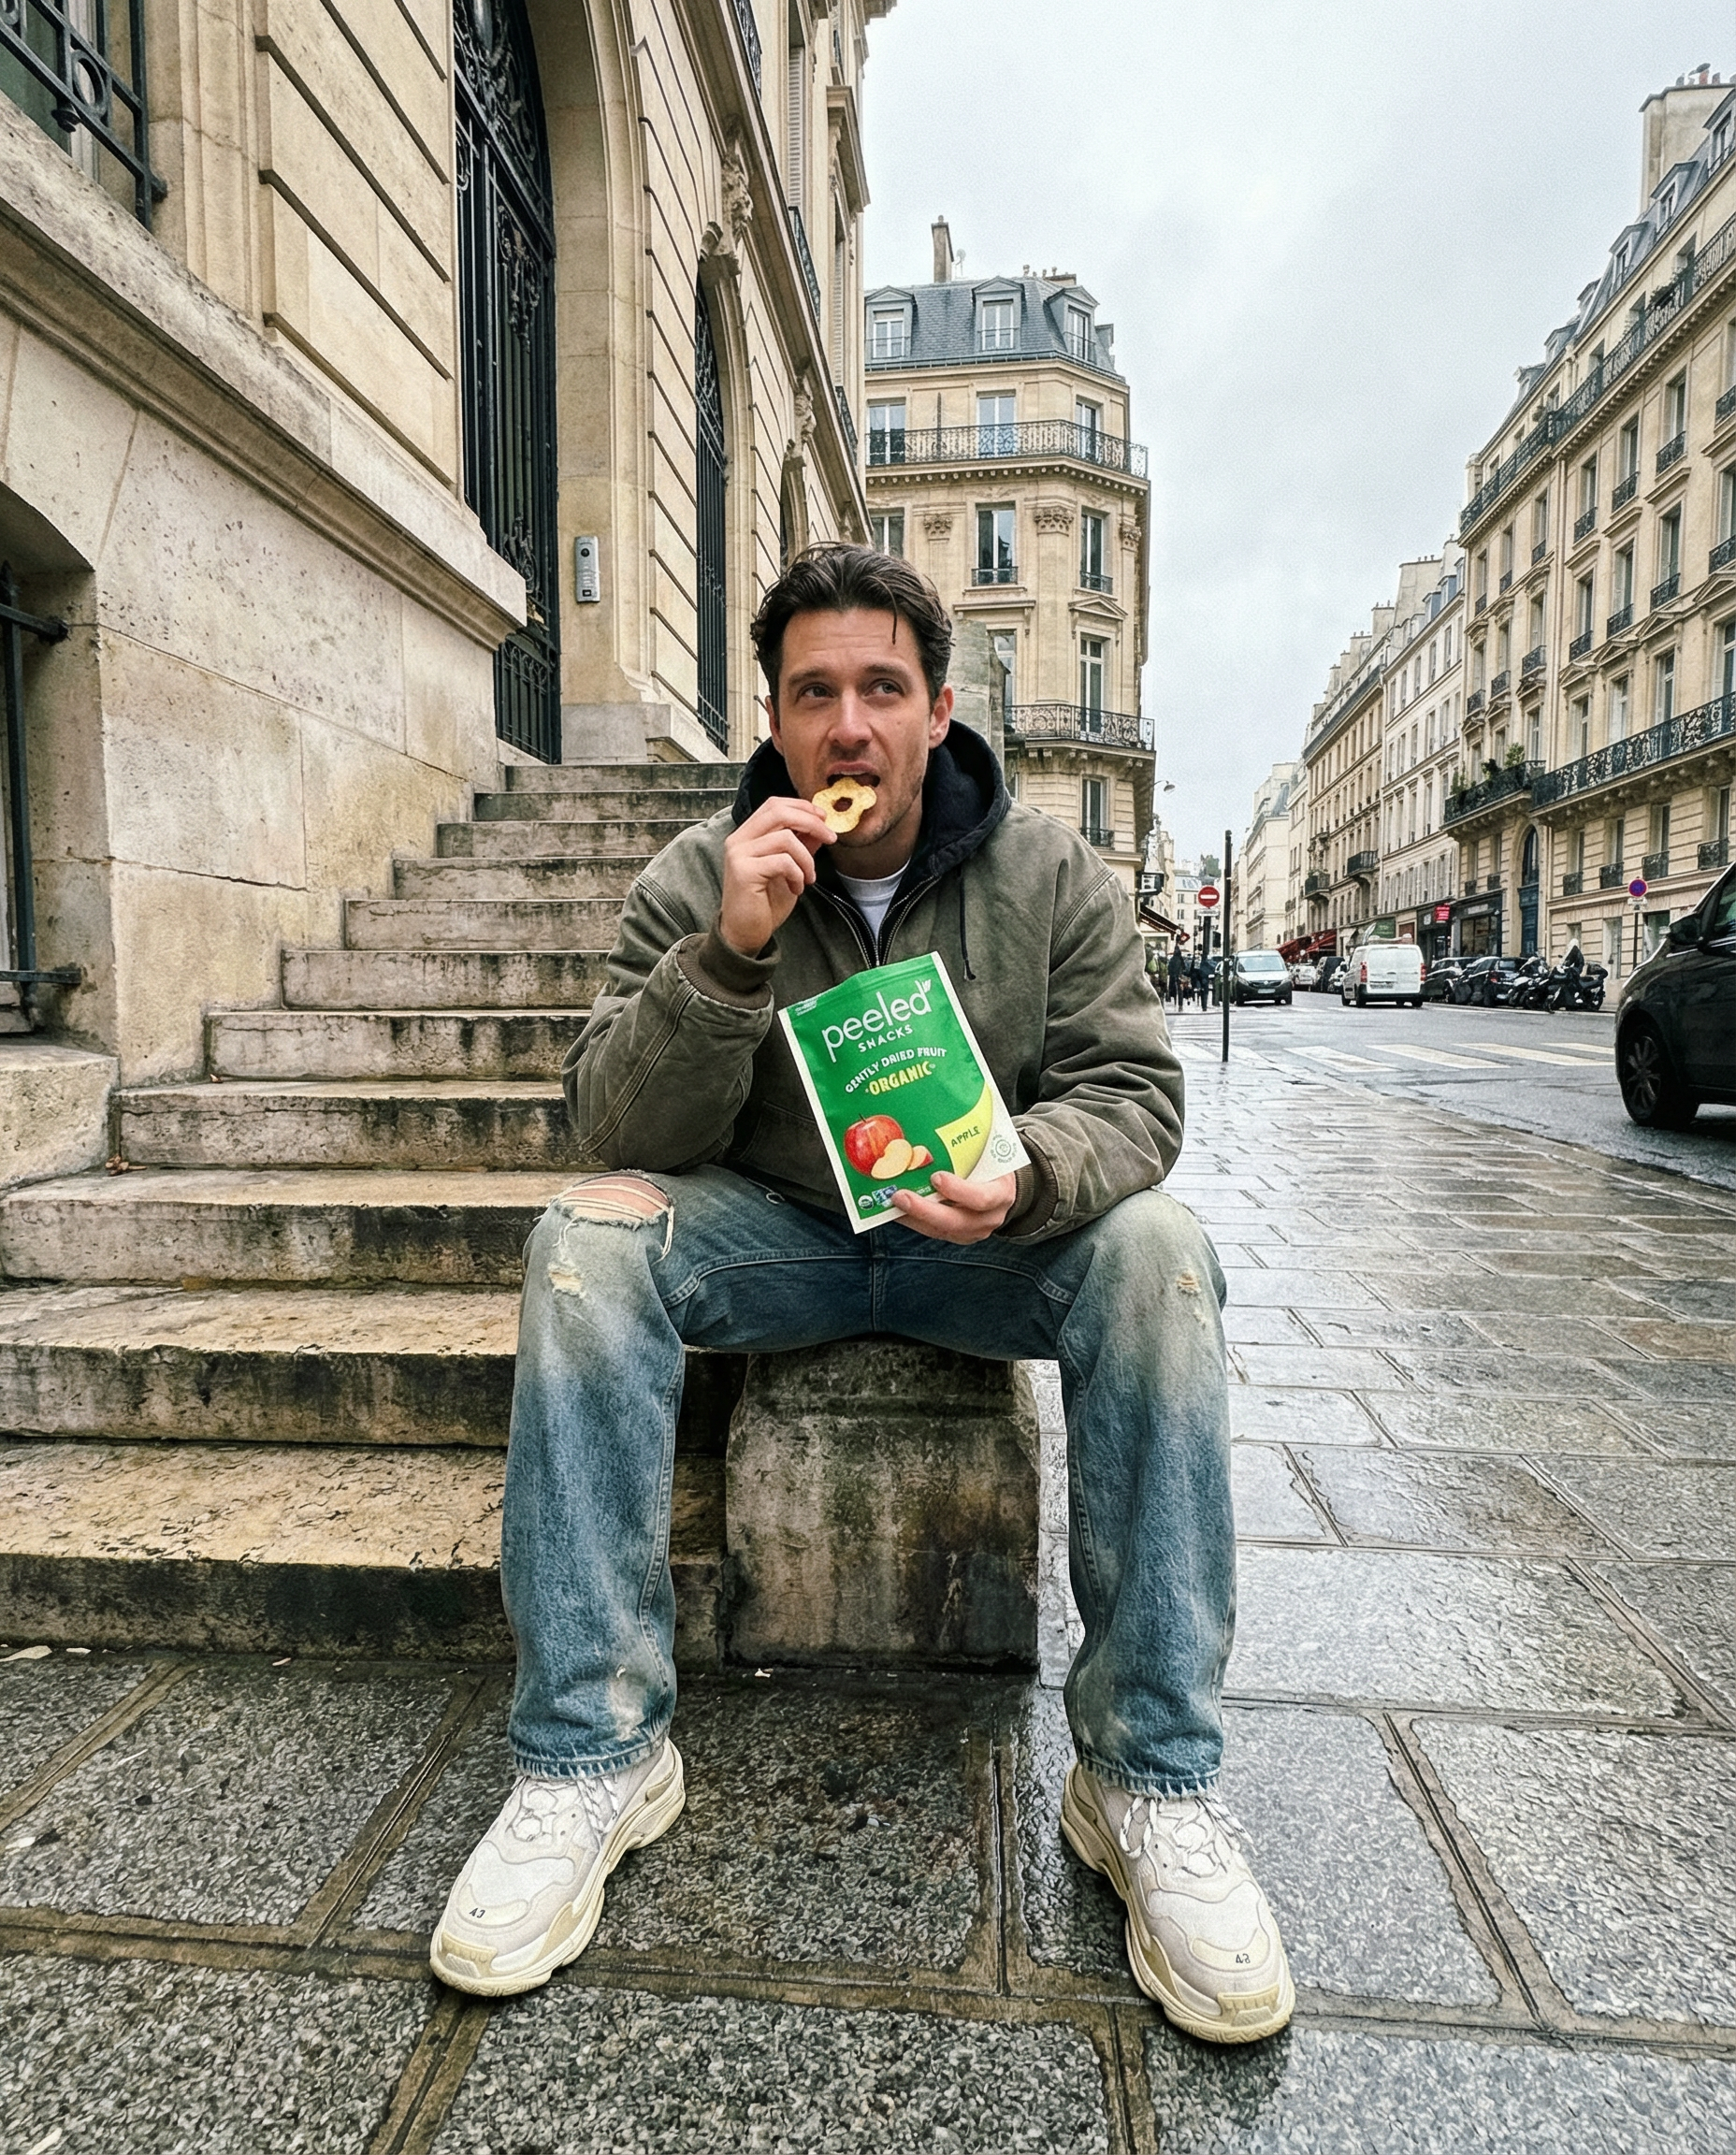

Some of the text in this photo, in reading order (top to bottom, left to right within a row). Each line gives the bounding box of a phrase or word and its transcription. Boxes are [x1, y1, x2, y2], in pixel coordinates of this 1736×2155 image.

[821, 978, 933, 1063] peeled
[858, 1024, 914, 1052] SNACKS
[881, 1049, 915, 1067] DRIED
[917, 1047, 948, 1057] FRUIT
[869, 1061, 933, 1095] ORGANIC
[951, 1125, 980, 1148] APPLE
